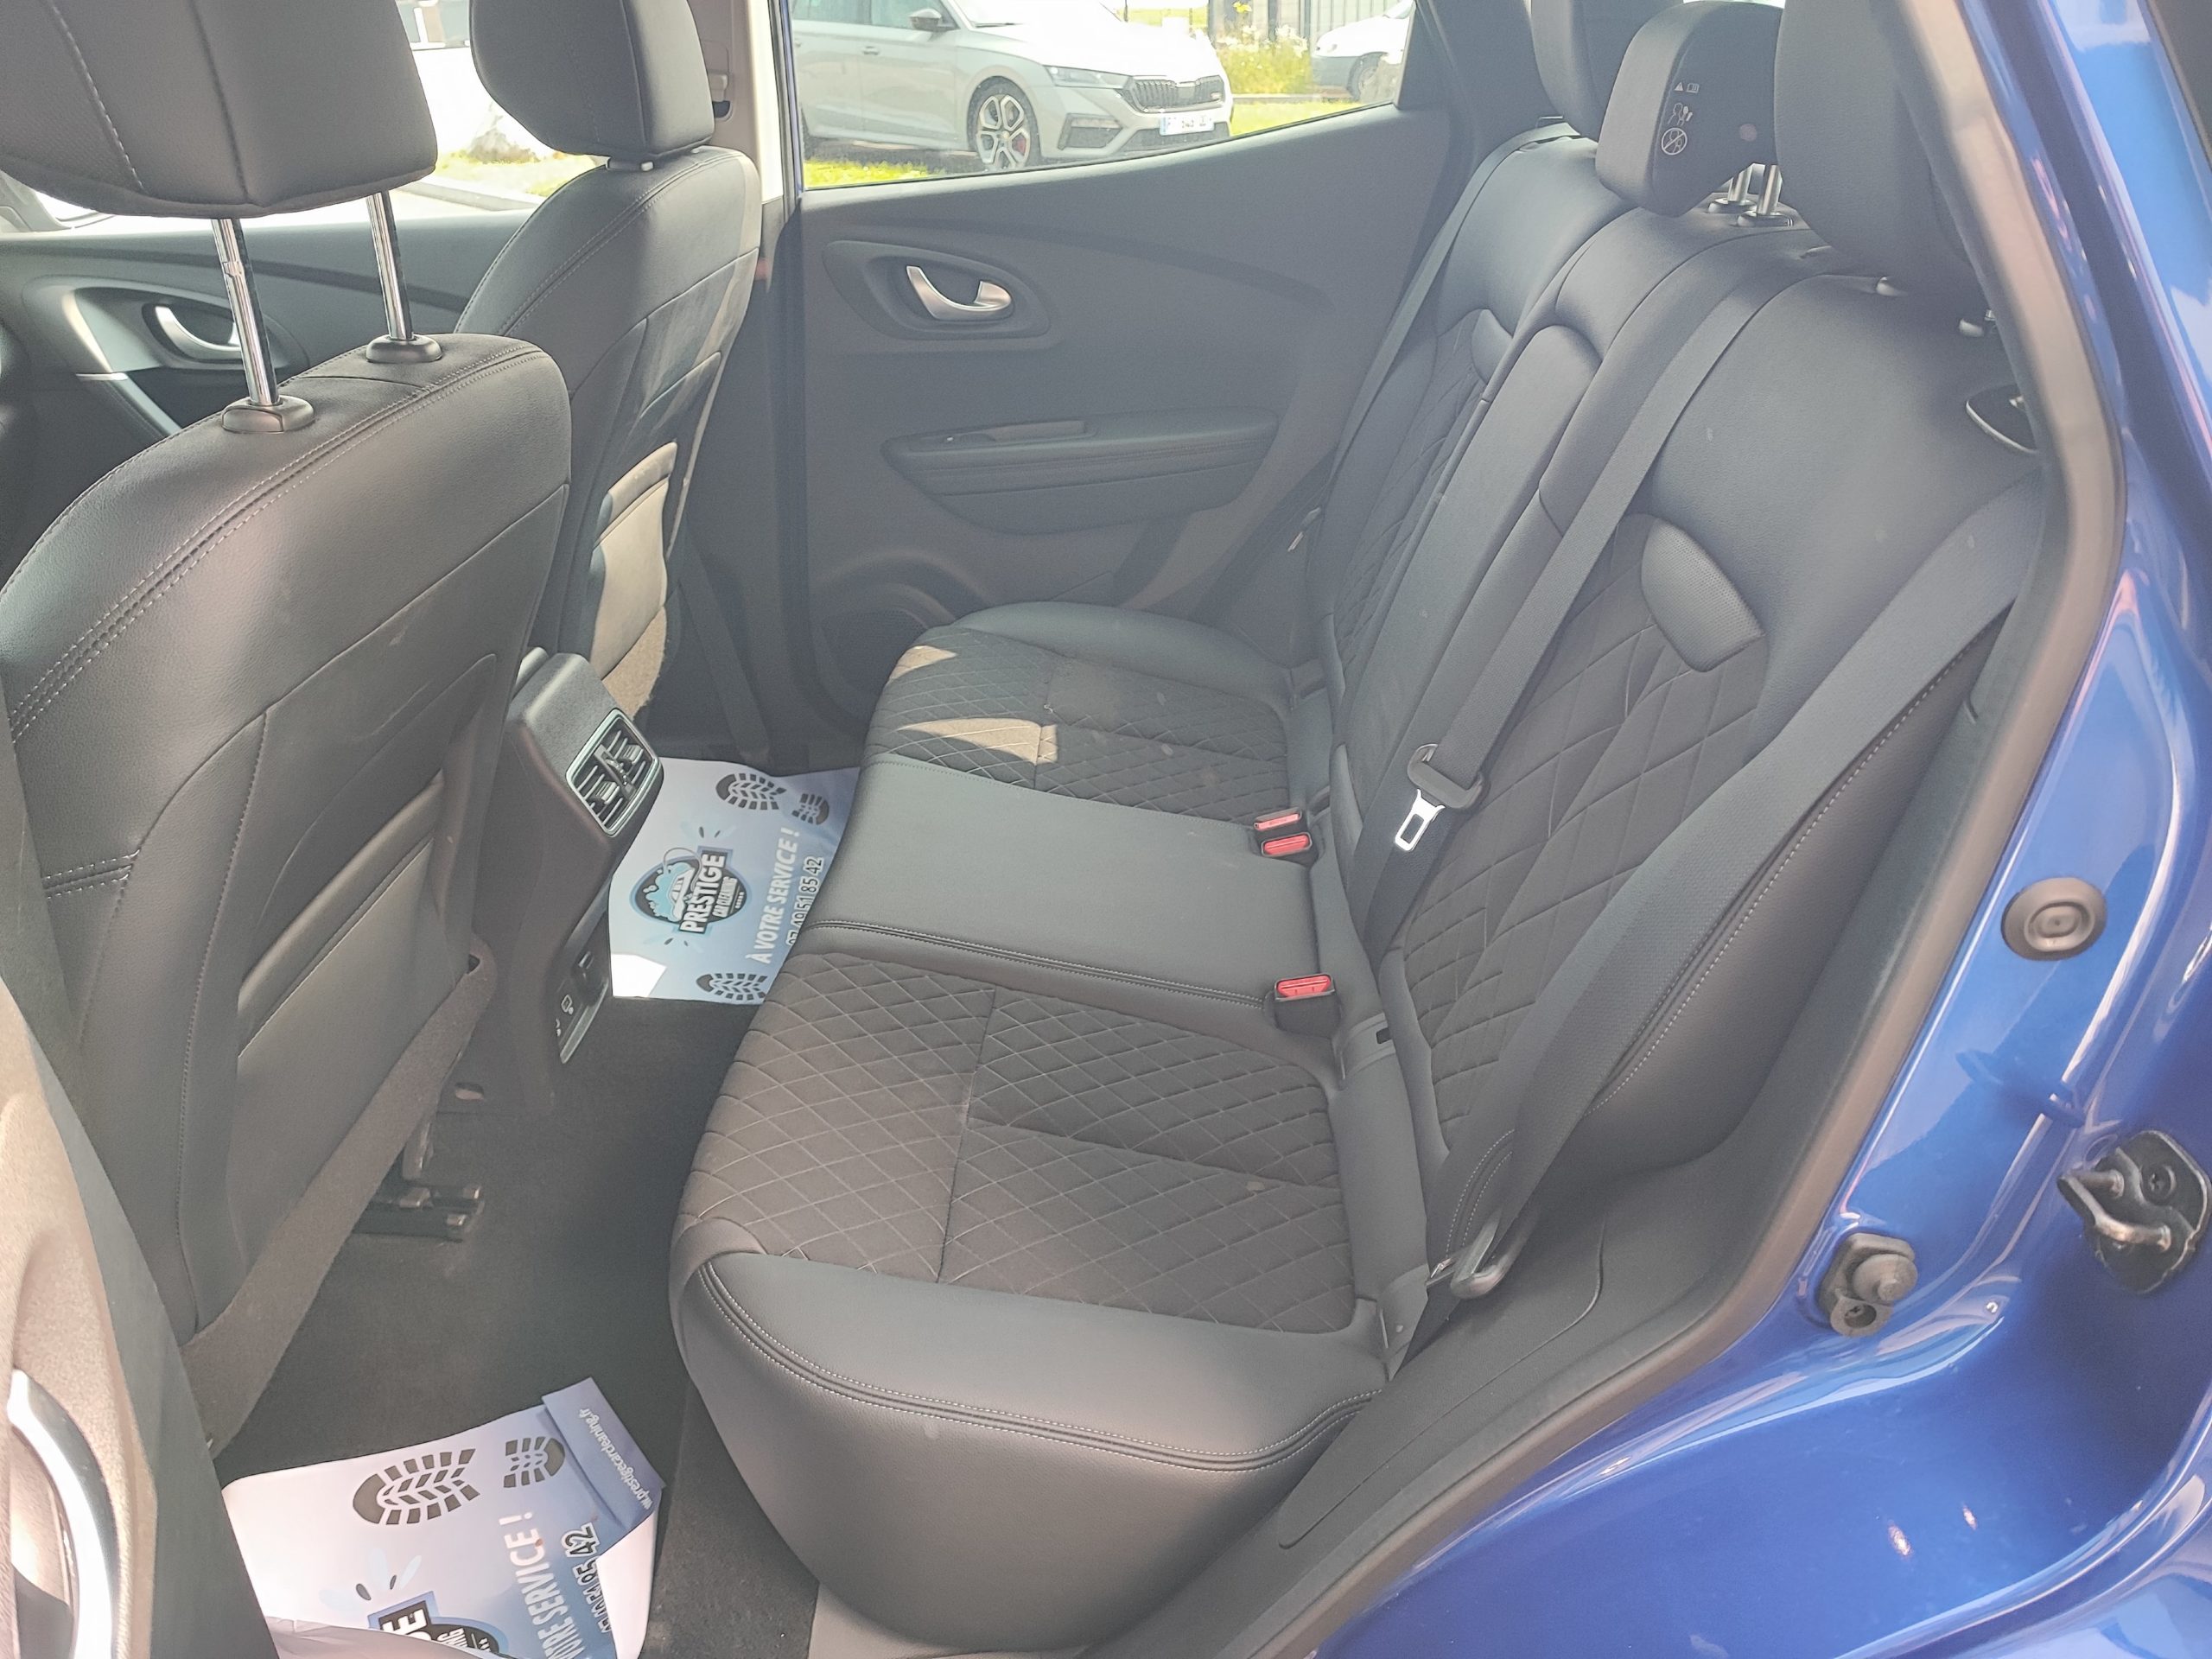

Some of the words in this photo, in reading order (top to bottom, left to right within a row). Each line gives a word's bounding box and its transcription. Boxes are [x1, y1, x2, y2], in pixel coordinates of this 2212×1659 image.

[780, 827, 800, 837] !
[766, 838, 798, 904] SERVICE
[803, 855, 824, 875] 42
[679, 854, 726, 932] PRESTIGE
[798, 875, 820, 895] 85
[753, 906, 785, 949] VOTRE
[745, 953, 773, 964] À
[499, 1511, 533, 1526] !
[562, 1522, 601, 1558] 42
[504, 1528, 569, 1625] SERVICE
